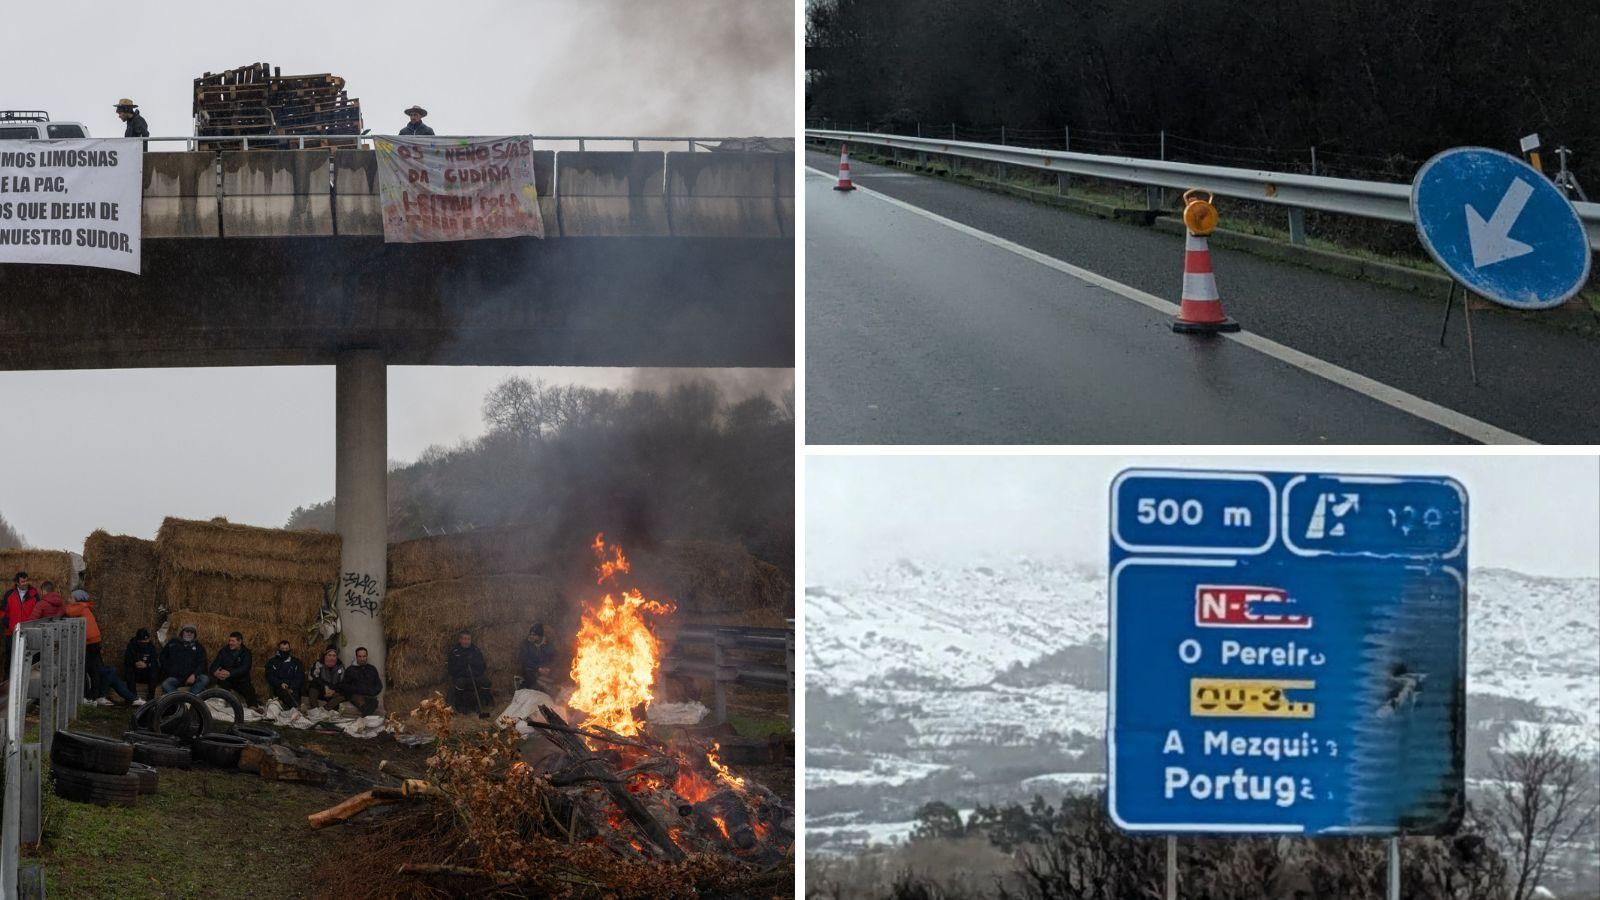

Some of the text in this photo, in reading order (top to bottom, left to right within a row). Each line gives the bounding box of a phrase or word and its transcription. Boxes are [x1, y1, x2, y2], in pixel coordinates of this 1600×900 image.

[0, 149, 118, 168] MOS LIMOSNAS
[12, 176, 30, 193] LA
[34, 177, 68, 194] PAC,
[408, 168, 430, 184] DA
[0, 202, 119, 221] S QUE DEJEN DE
[0, 228, 133, 254] NUESTRO SUDOR.
[1136, 497, 1252, 527] 500 m
[1178, 638, 1202, 664] O
[1196, 687, 1309, 711] OU-3
[1163, 729, 1185, 754] A
[1164, 767, 1326, 807] Portug
